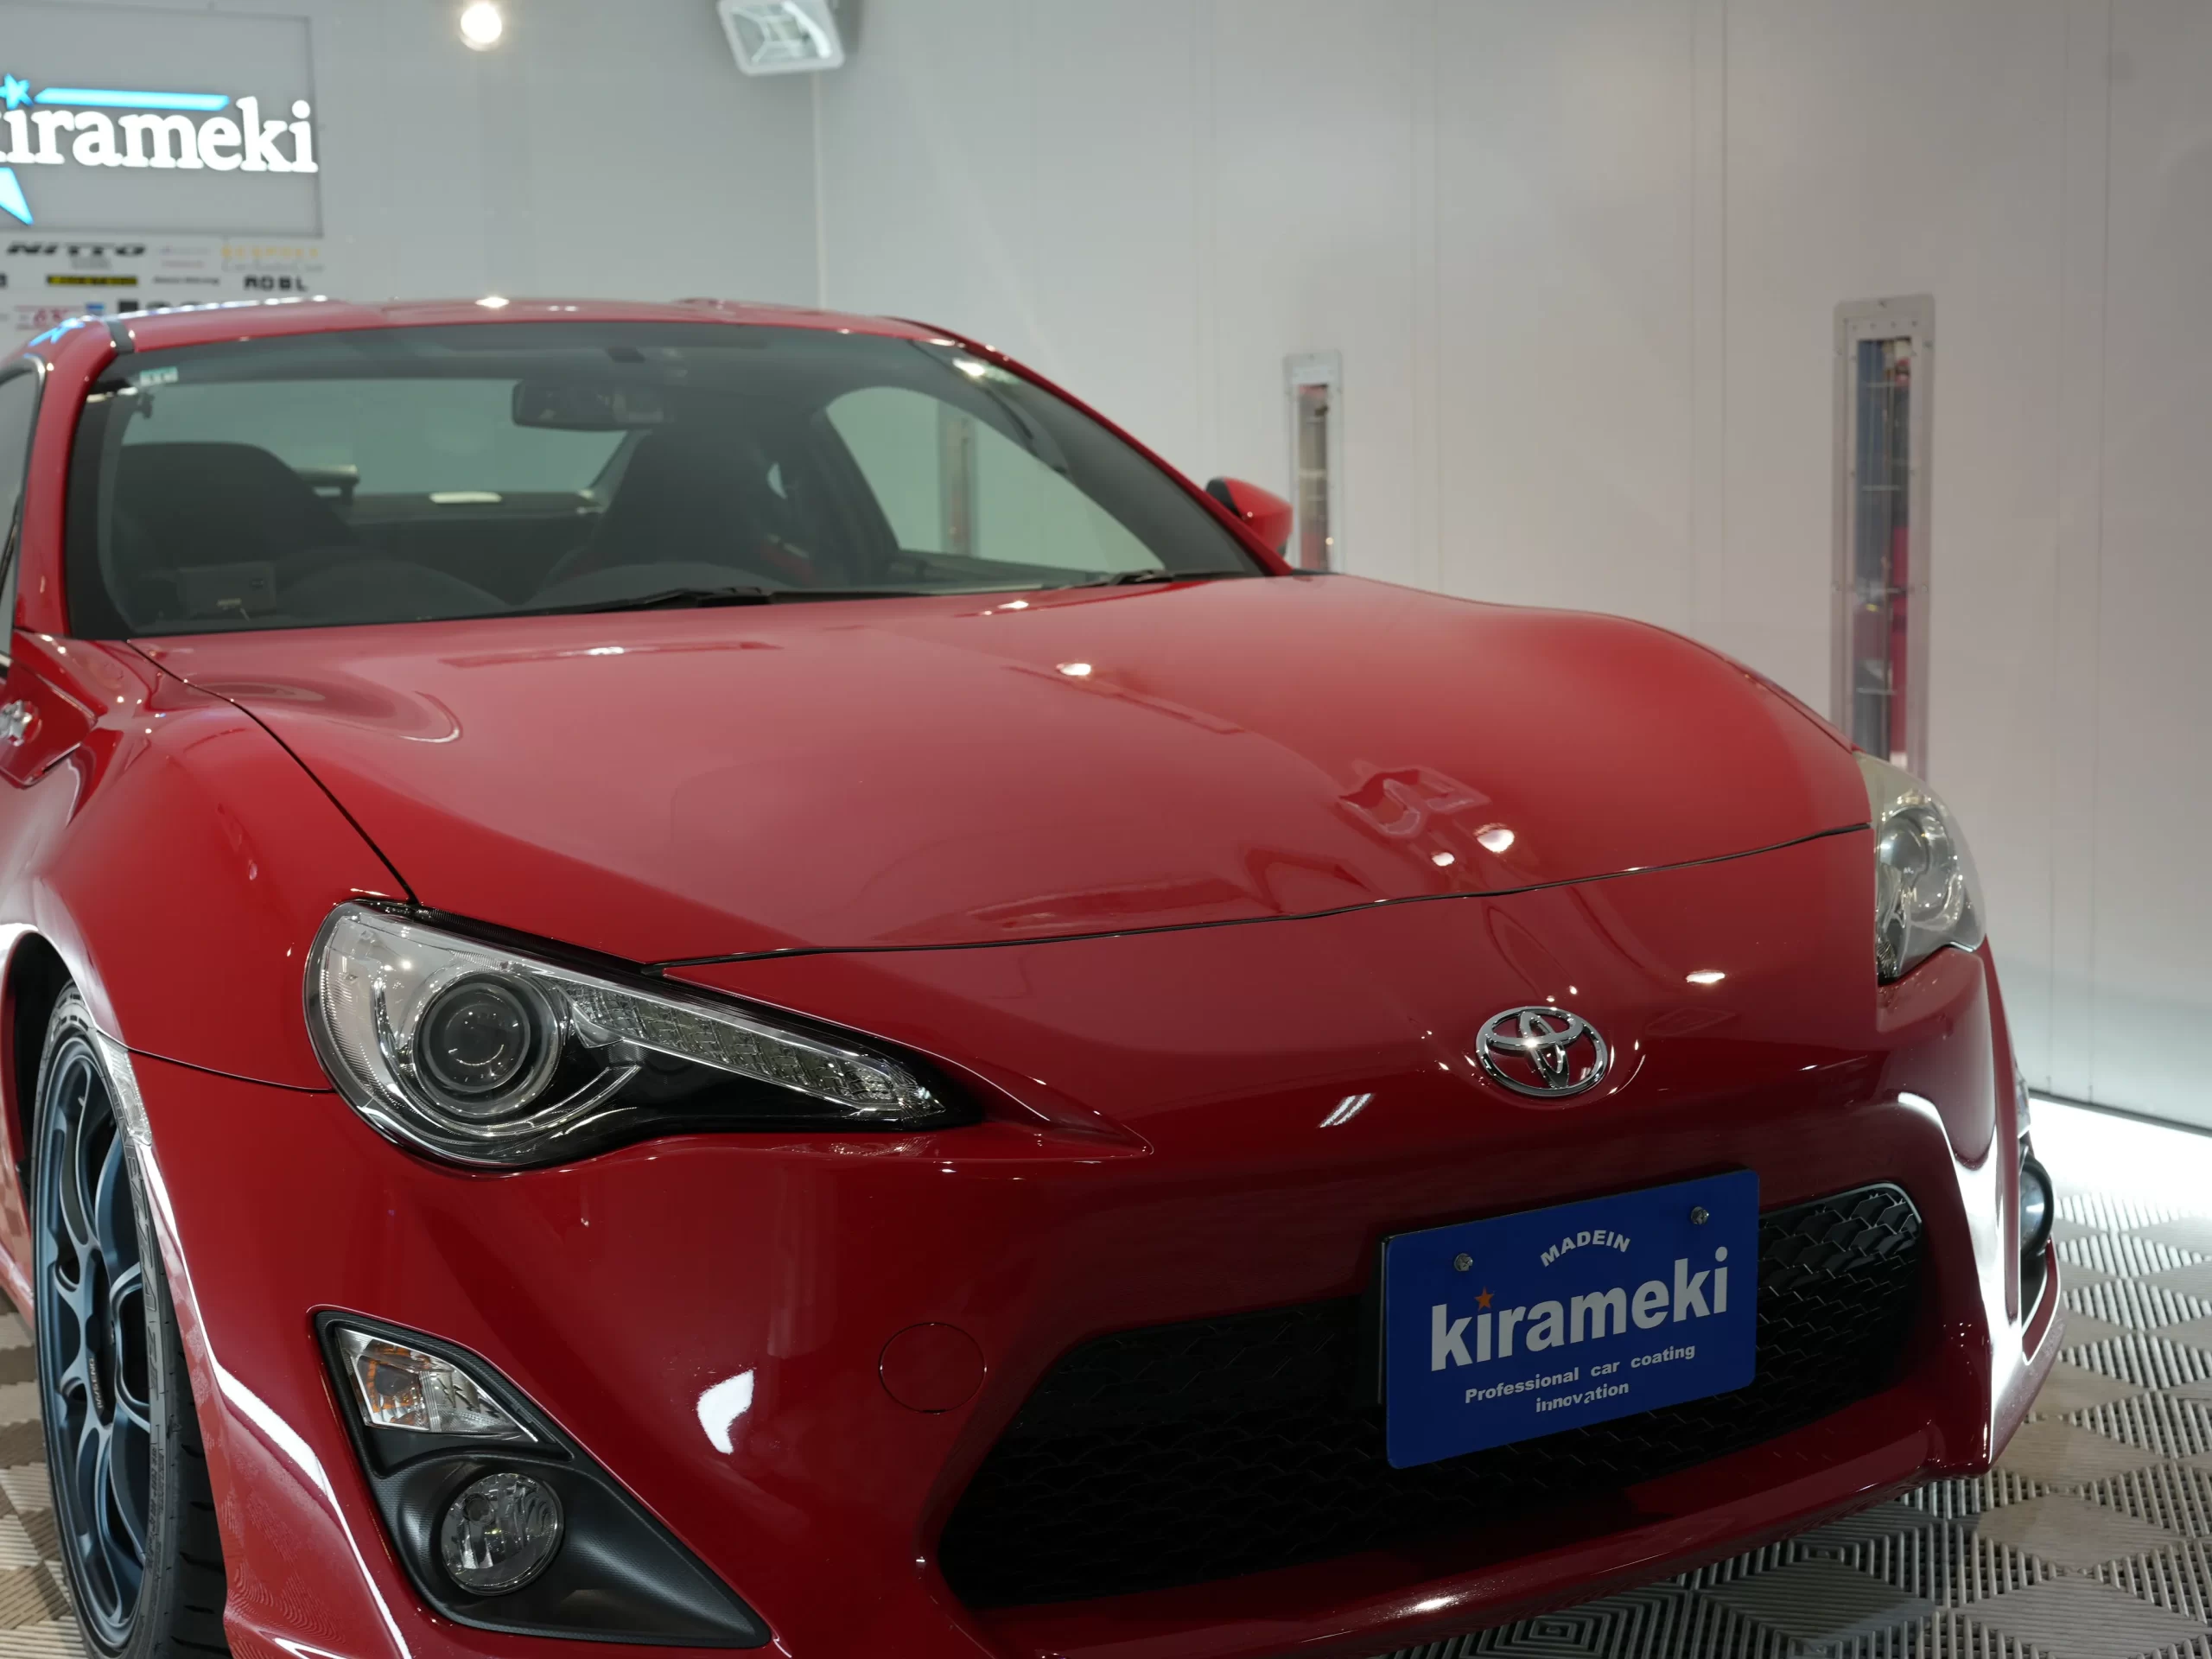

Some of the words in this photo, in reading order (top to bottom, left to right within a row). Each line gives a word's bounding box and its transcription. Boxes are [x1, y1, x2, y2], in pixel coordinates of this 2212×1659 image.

[0, 96, 319, 173] irameki
[7, 242, 146, 257] NITTO
[1540, 1229, 1631, 1268] MADEIN
[1431, 1246, 1728, 1372] kirameki
[1465, 1367, 1580, 1404] Professional
[1591, 1361, 1621, 1377] car
[1630, 1345, 1695, 1369] coating
[1535, 1382, 1630, 1413] innovation
